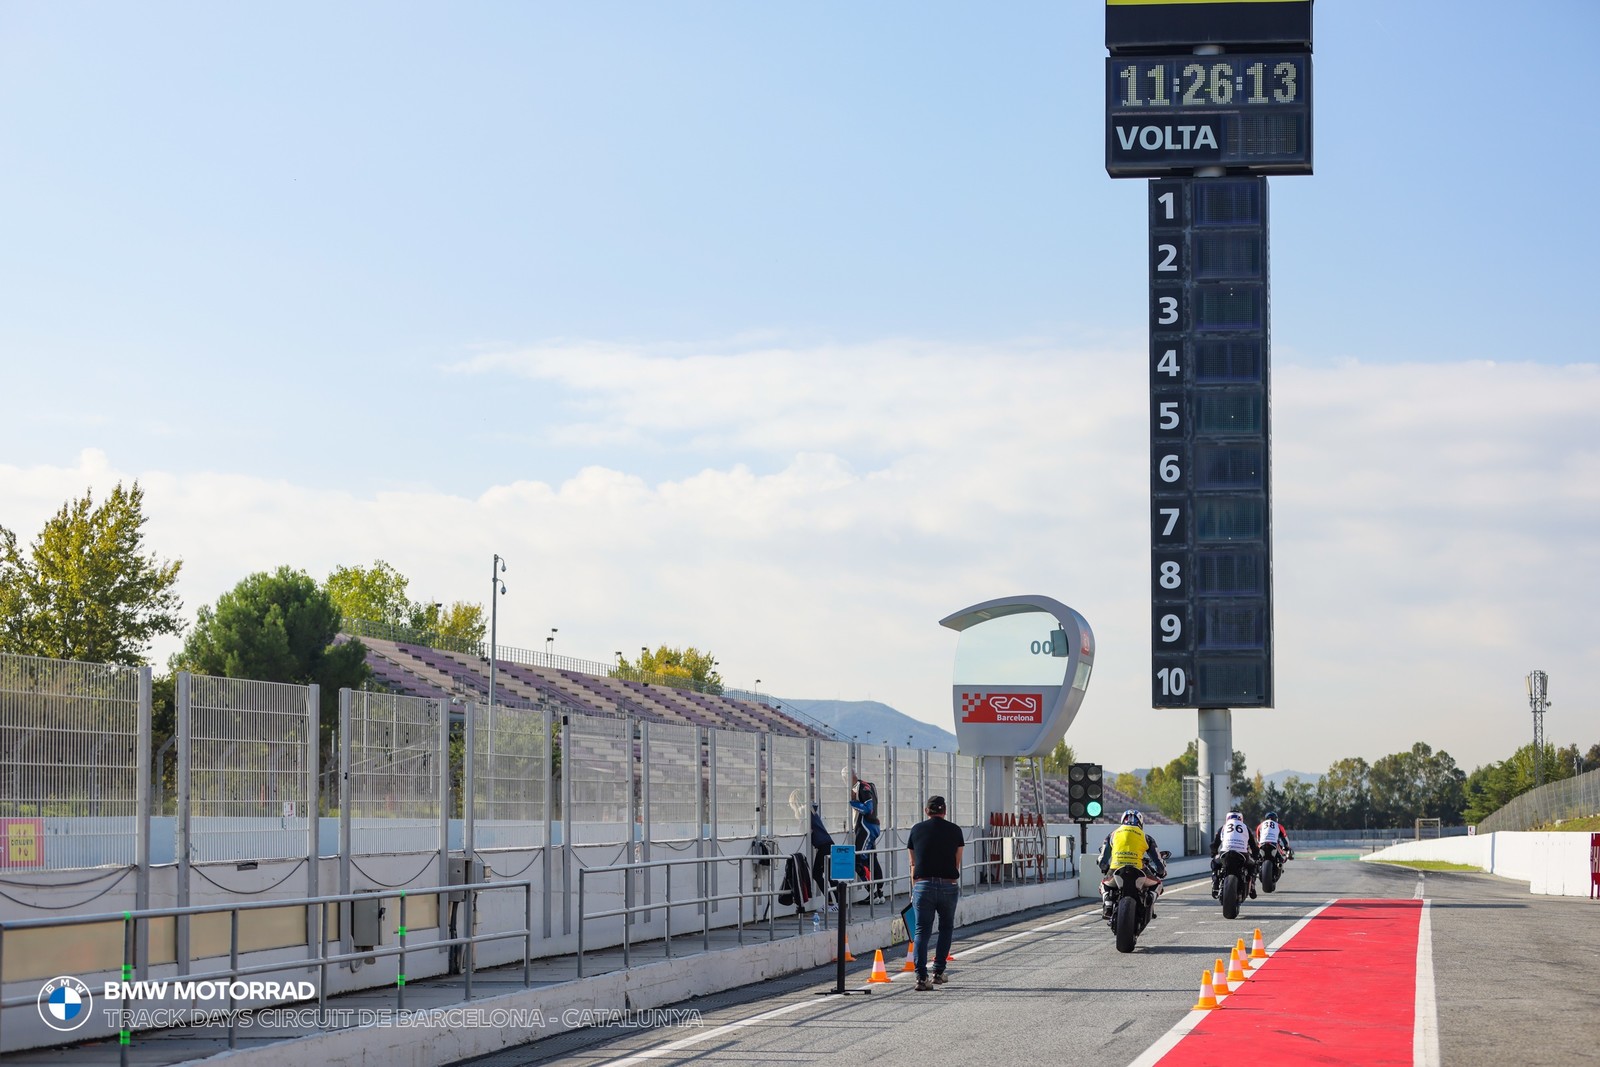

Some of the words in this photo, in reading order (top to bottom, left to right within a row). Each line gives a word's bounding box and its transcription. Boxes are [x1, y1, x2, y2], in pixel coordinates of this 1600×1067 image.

[1120, 62, 1296, 106] 11:26:13
[1116, 125, 1218, 150] VOLTA
[1157, 192, 1174, 219] 1
[1157, 244, 1178, 271] 2
[1158, 297, 1179, 324] 3
[1157, 350, 1180, 376] 4
[1159, 402, 1180, 429] 5
[1159, 455, 1181, 482] 6
[1159, 508, 1180, 535] 7
[1160, 561, 1181, 588] 8
[1160, 614, 1182, 642] 9
[1157, 667, 1186, 695] 10
[997, 714, 1034, 722] Barcelona
[1227, 823, 1243, 833] 36
[1264, 821, 1275, 829] 38
